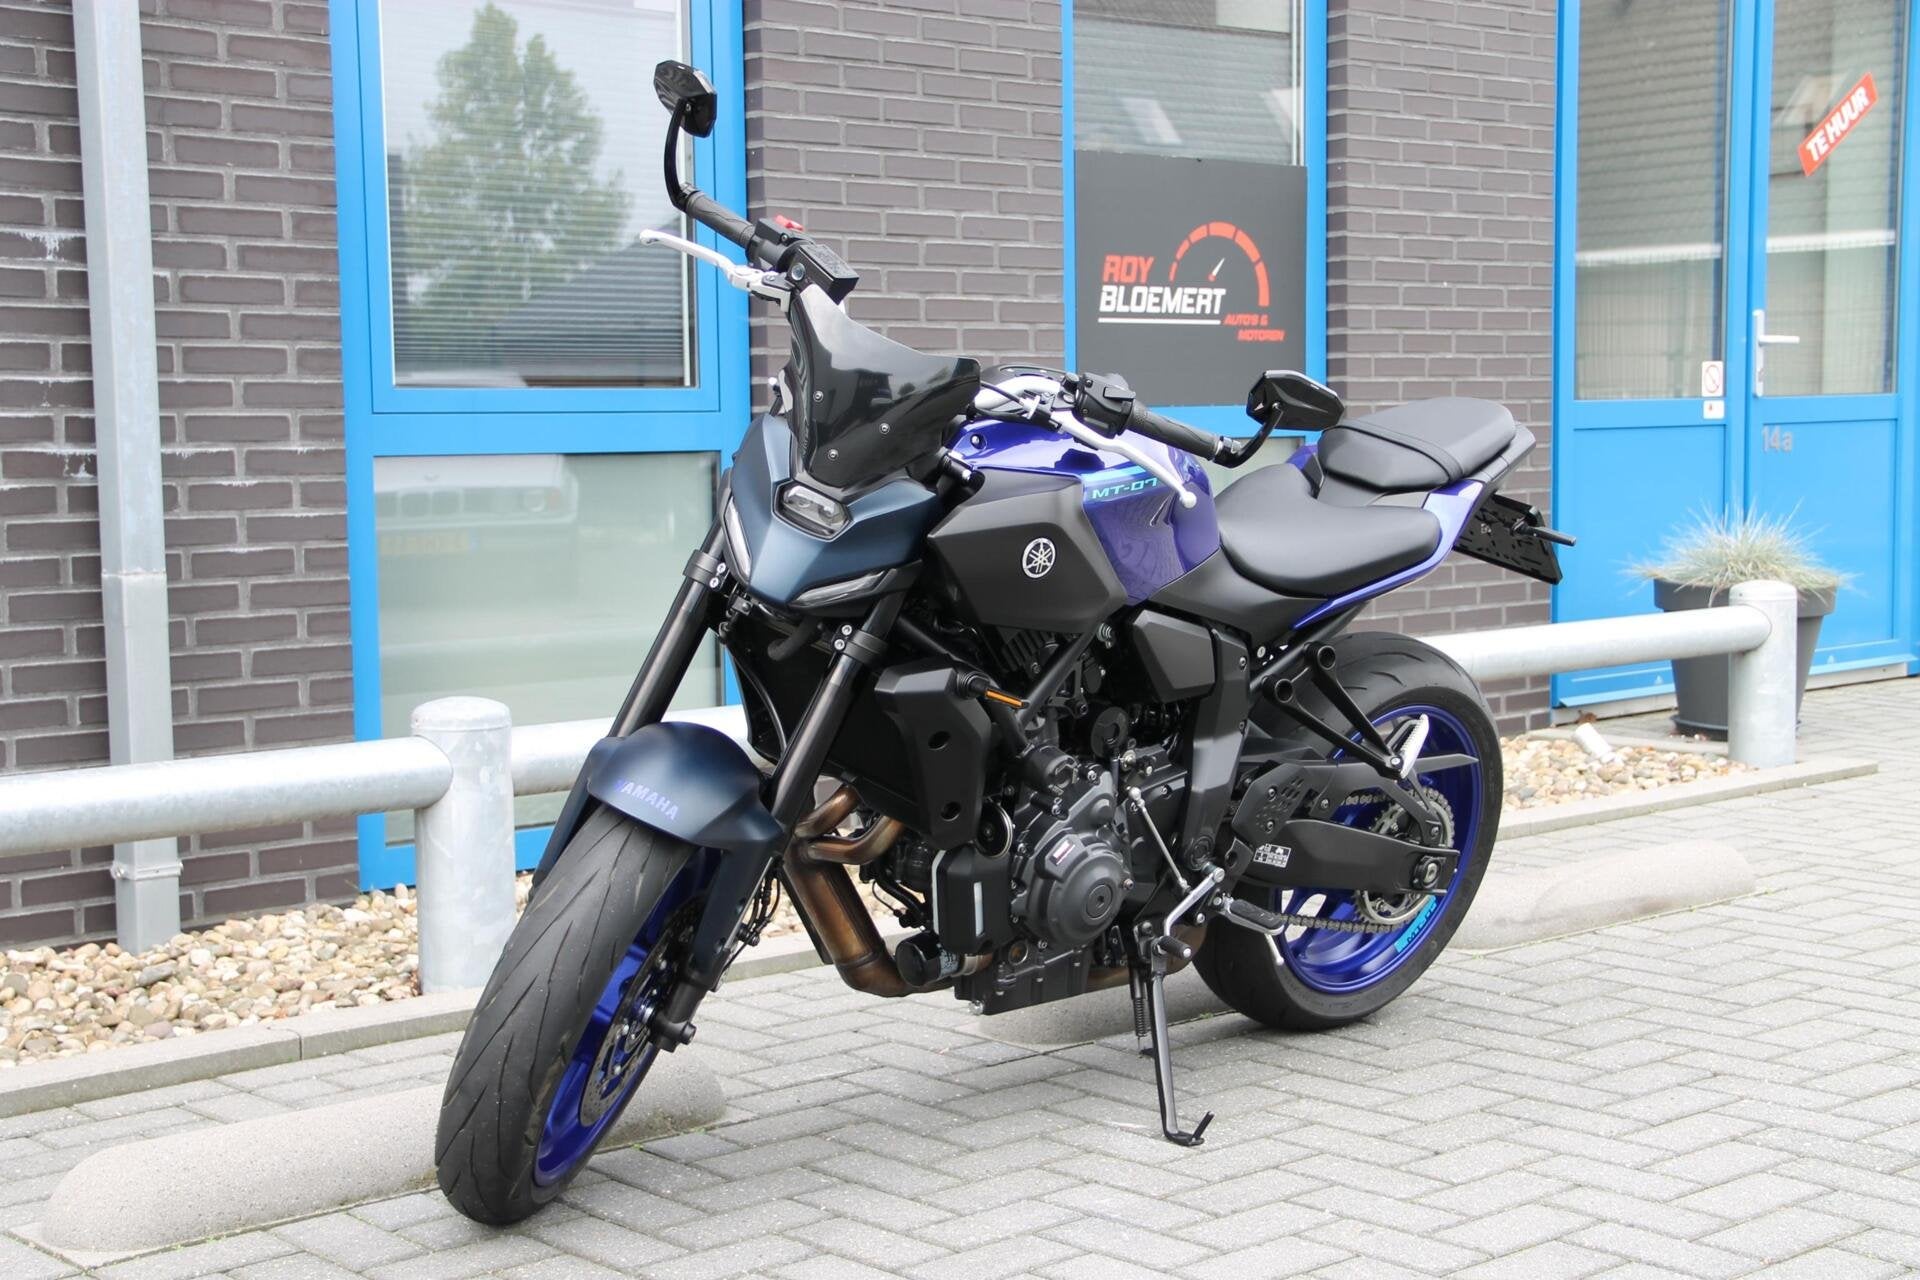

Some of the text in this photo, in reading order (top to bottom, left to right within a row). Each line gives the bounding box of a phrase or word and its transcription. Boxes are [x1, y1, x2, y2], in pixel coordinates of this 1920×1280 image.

[1806, 86, 1870, 162] TE HUUR
[1103, 255, 1155, 284] ROY
[1099, 285, 1227, 314] BLOEMERT
[1762, 425, 1793, 454] 14a
[1092, 477, 1158, 499] MT-07
[615, 780, 679, 820] YAMAHA
